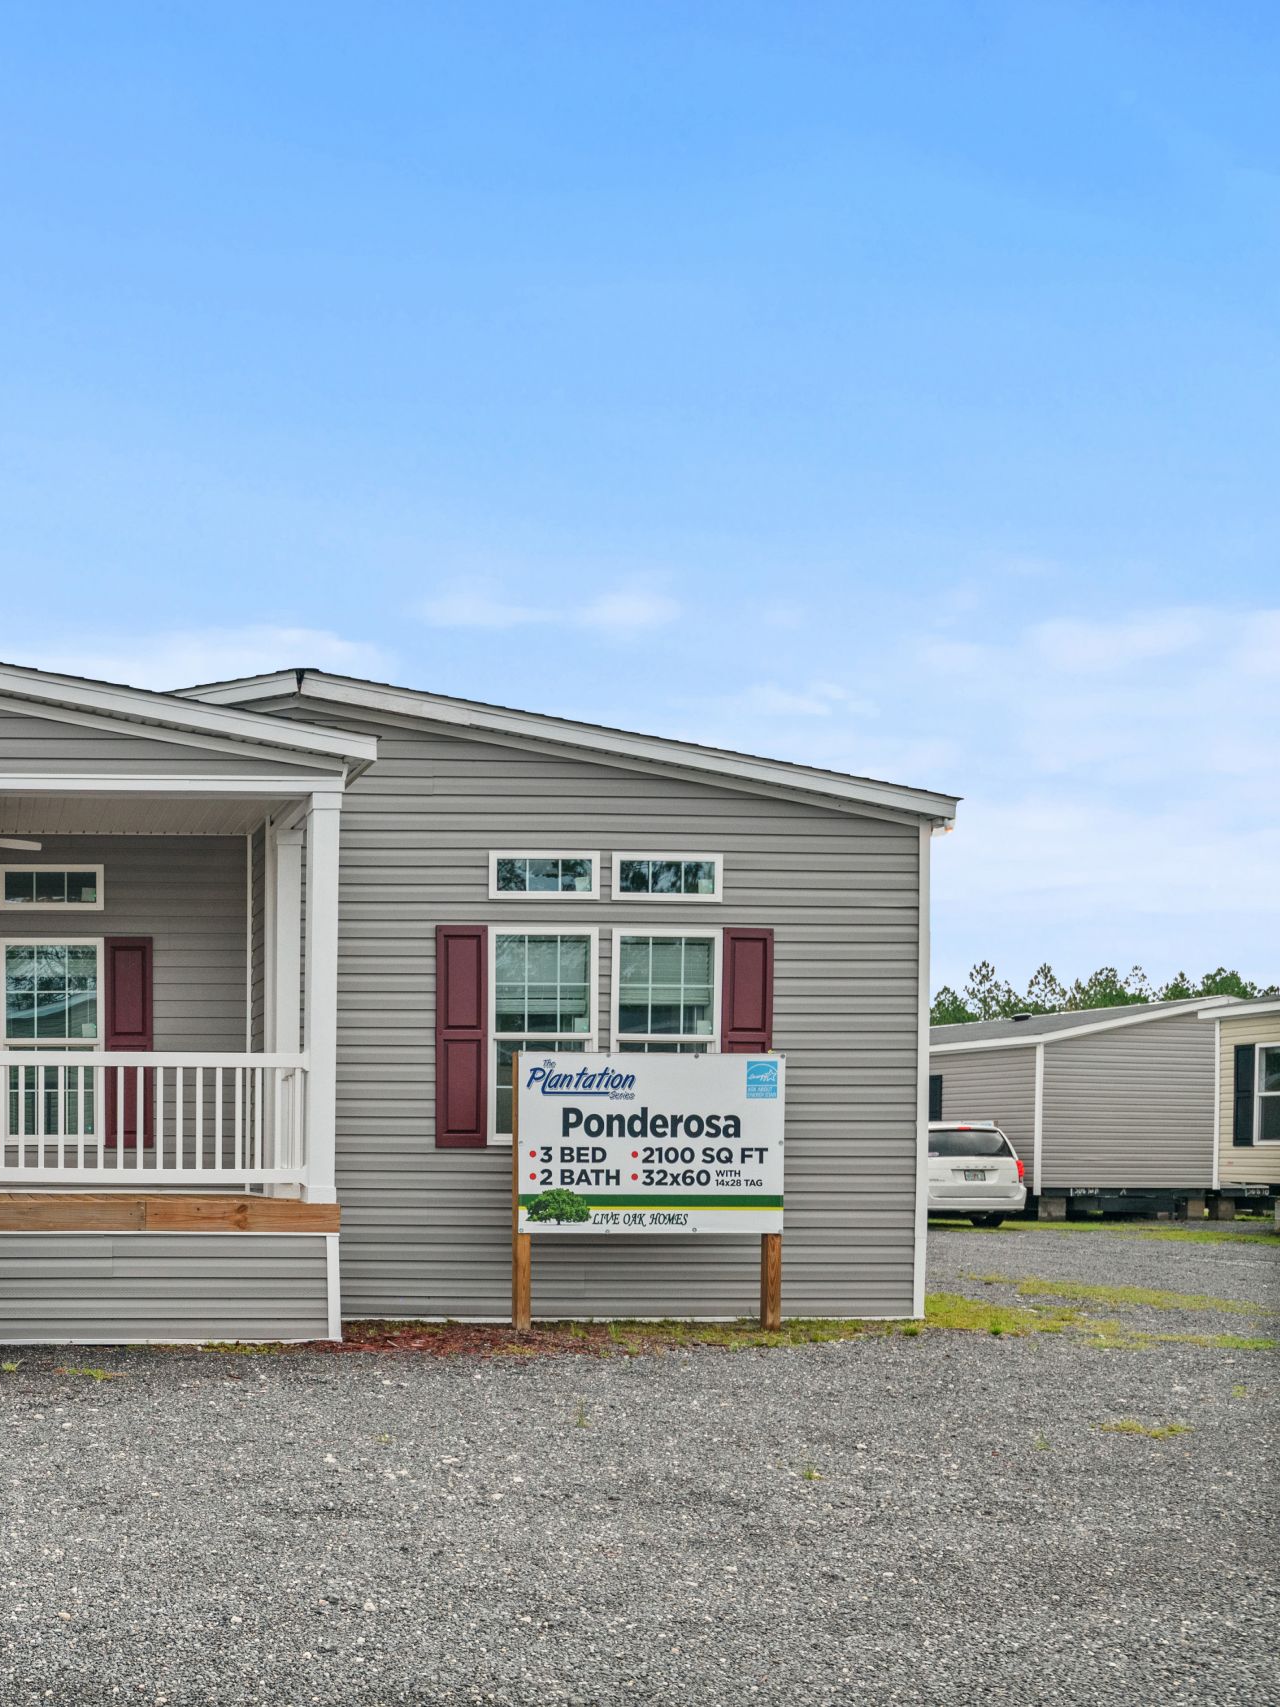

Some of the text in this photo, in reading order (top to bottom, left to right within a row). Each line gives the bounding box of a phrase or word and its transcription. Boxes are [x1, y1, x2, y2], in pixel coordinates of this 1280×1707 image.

[543, 1059, 557, 1069] The
[526, 1066, 637, 1095] Plantation
[608, 1090, 636, 1100] Series
[562, 1107, 742, 1138] Ponderosa
[540, 1146, 607, 1163] 3 BED
[642, 1147, 768, 1164] 2100 SQ FT
[540, 1169, 620, 1186] 2 BATH
[642, 1169, 711, 1186] 32x60
[715, 1170, 741, 1178] WITH
[715, 1179, 763, 1187] 14x28 TAG
[592, 1211, 689, 1227] LIVE OAK HOMES
